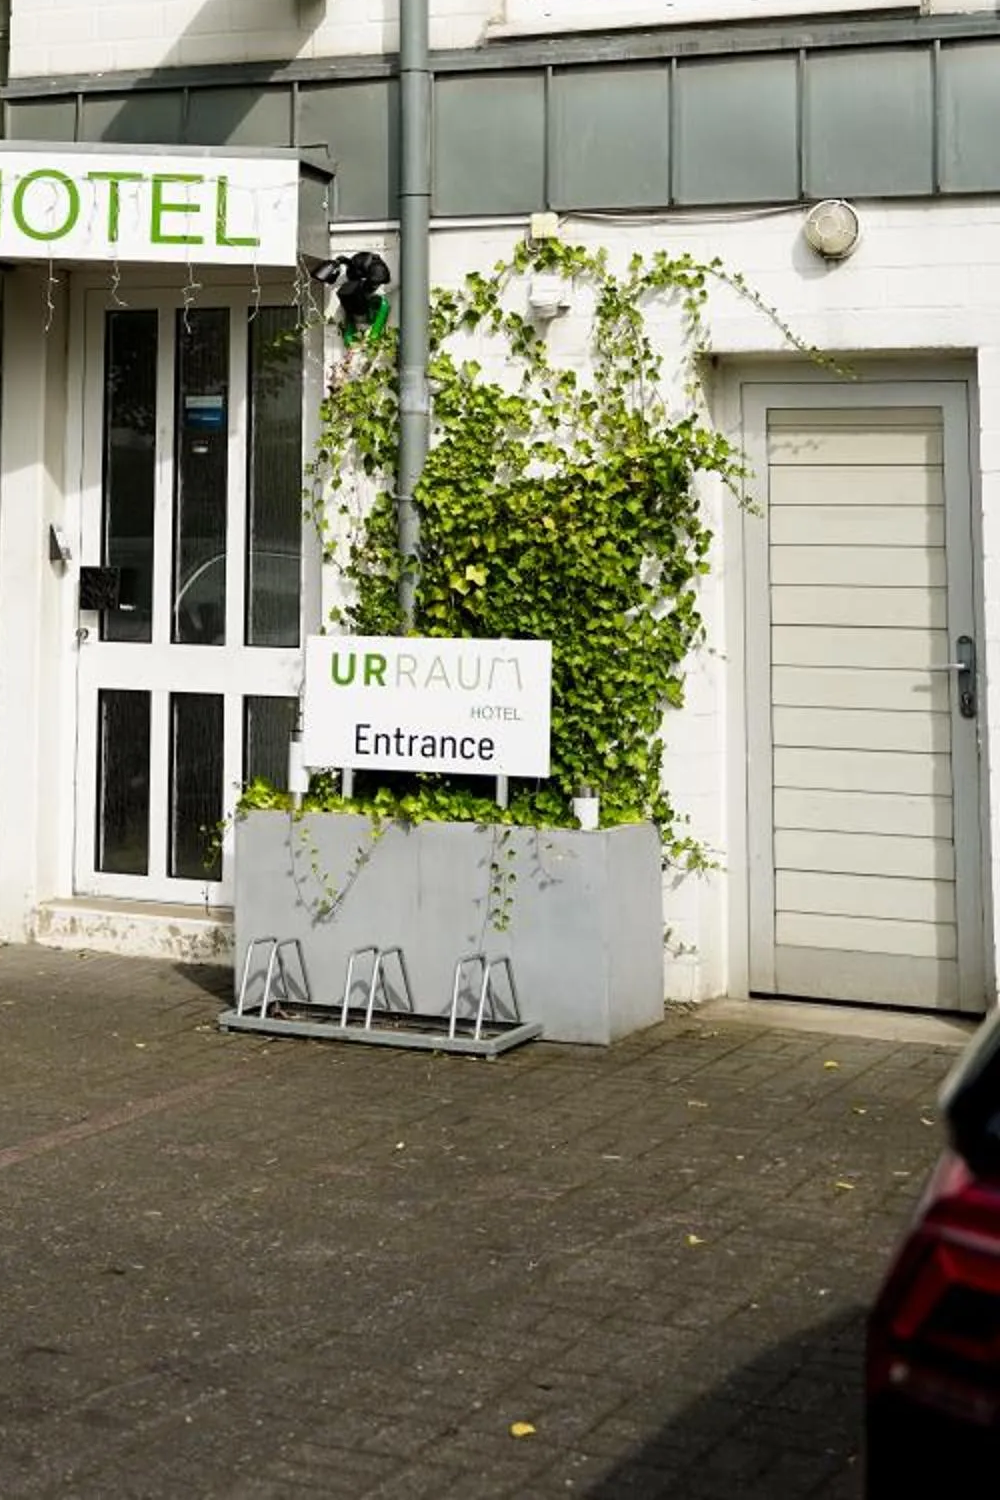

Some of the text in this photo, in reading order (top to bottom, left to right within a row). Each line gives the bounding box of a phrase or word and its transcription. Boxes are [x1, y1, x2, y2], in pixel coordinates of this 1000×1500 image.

[331, 652, 523, 692] URRAUM
[470, 706, 522, 721] HOTEL
[355, 723, 495, 761] Entrance
